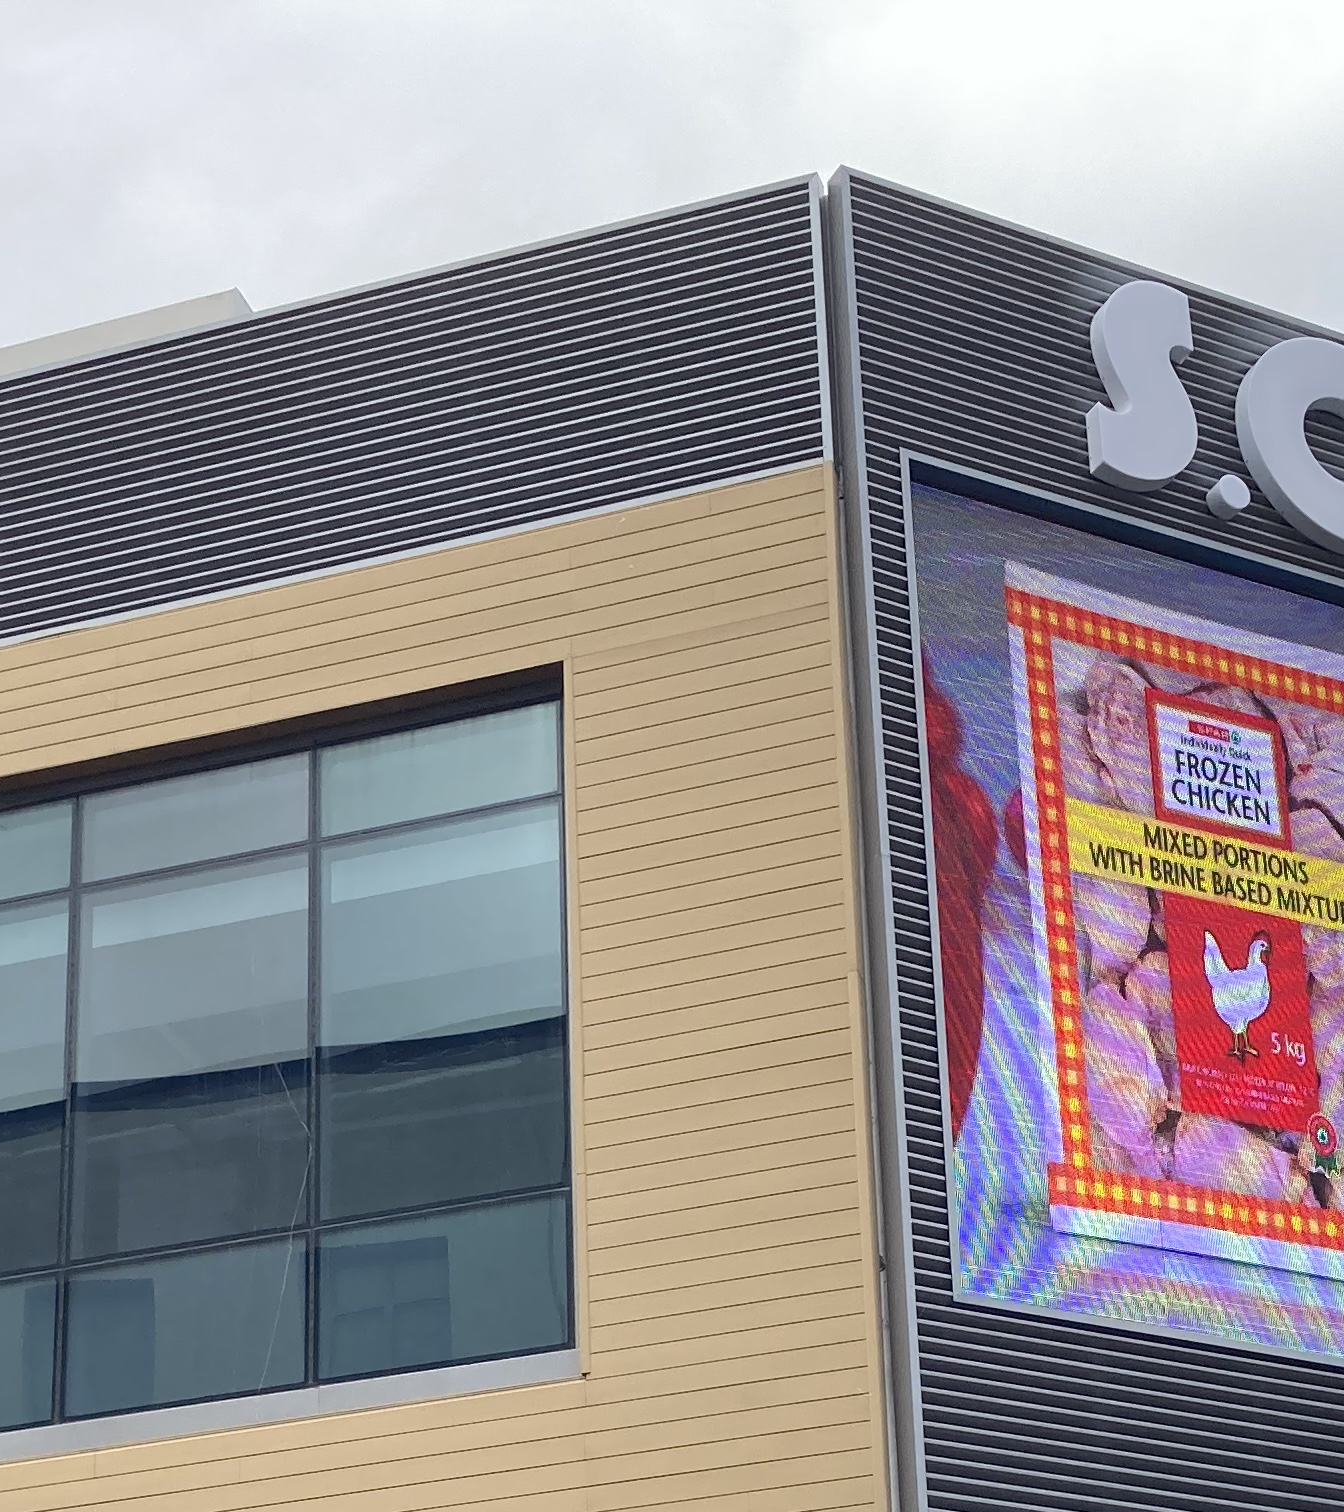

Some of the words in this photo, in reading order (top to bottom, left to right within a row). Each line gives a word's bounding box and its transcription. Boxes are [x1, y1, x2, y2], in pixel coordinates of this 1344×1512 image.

[1175, 748, 1261, 795] FROZEN
[1172, 779, 1270, 825] CHICKEN
[1089, 841, 1144, 879] WITH
[1149, 856, 1206, 893] BRINE
[1211, 871, 1272, 906] BASED
[1143, 823, 1206, 861] MIXED
[1213, 840, 1309, 885] PORTIONS
[1271, 1031, 1281, 1055] 5
[1285, 1033, 1306, 1067] kg
